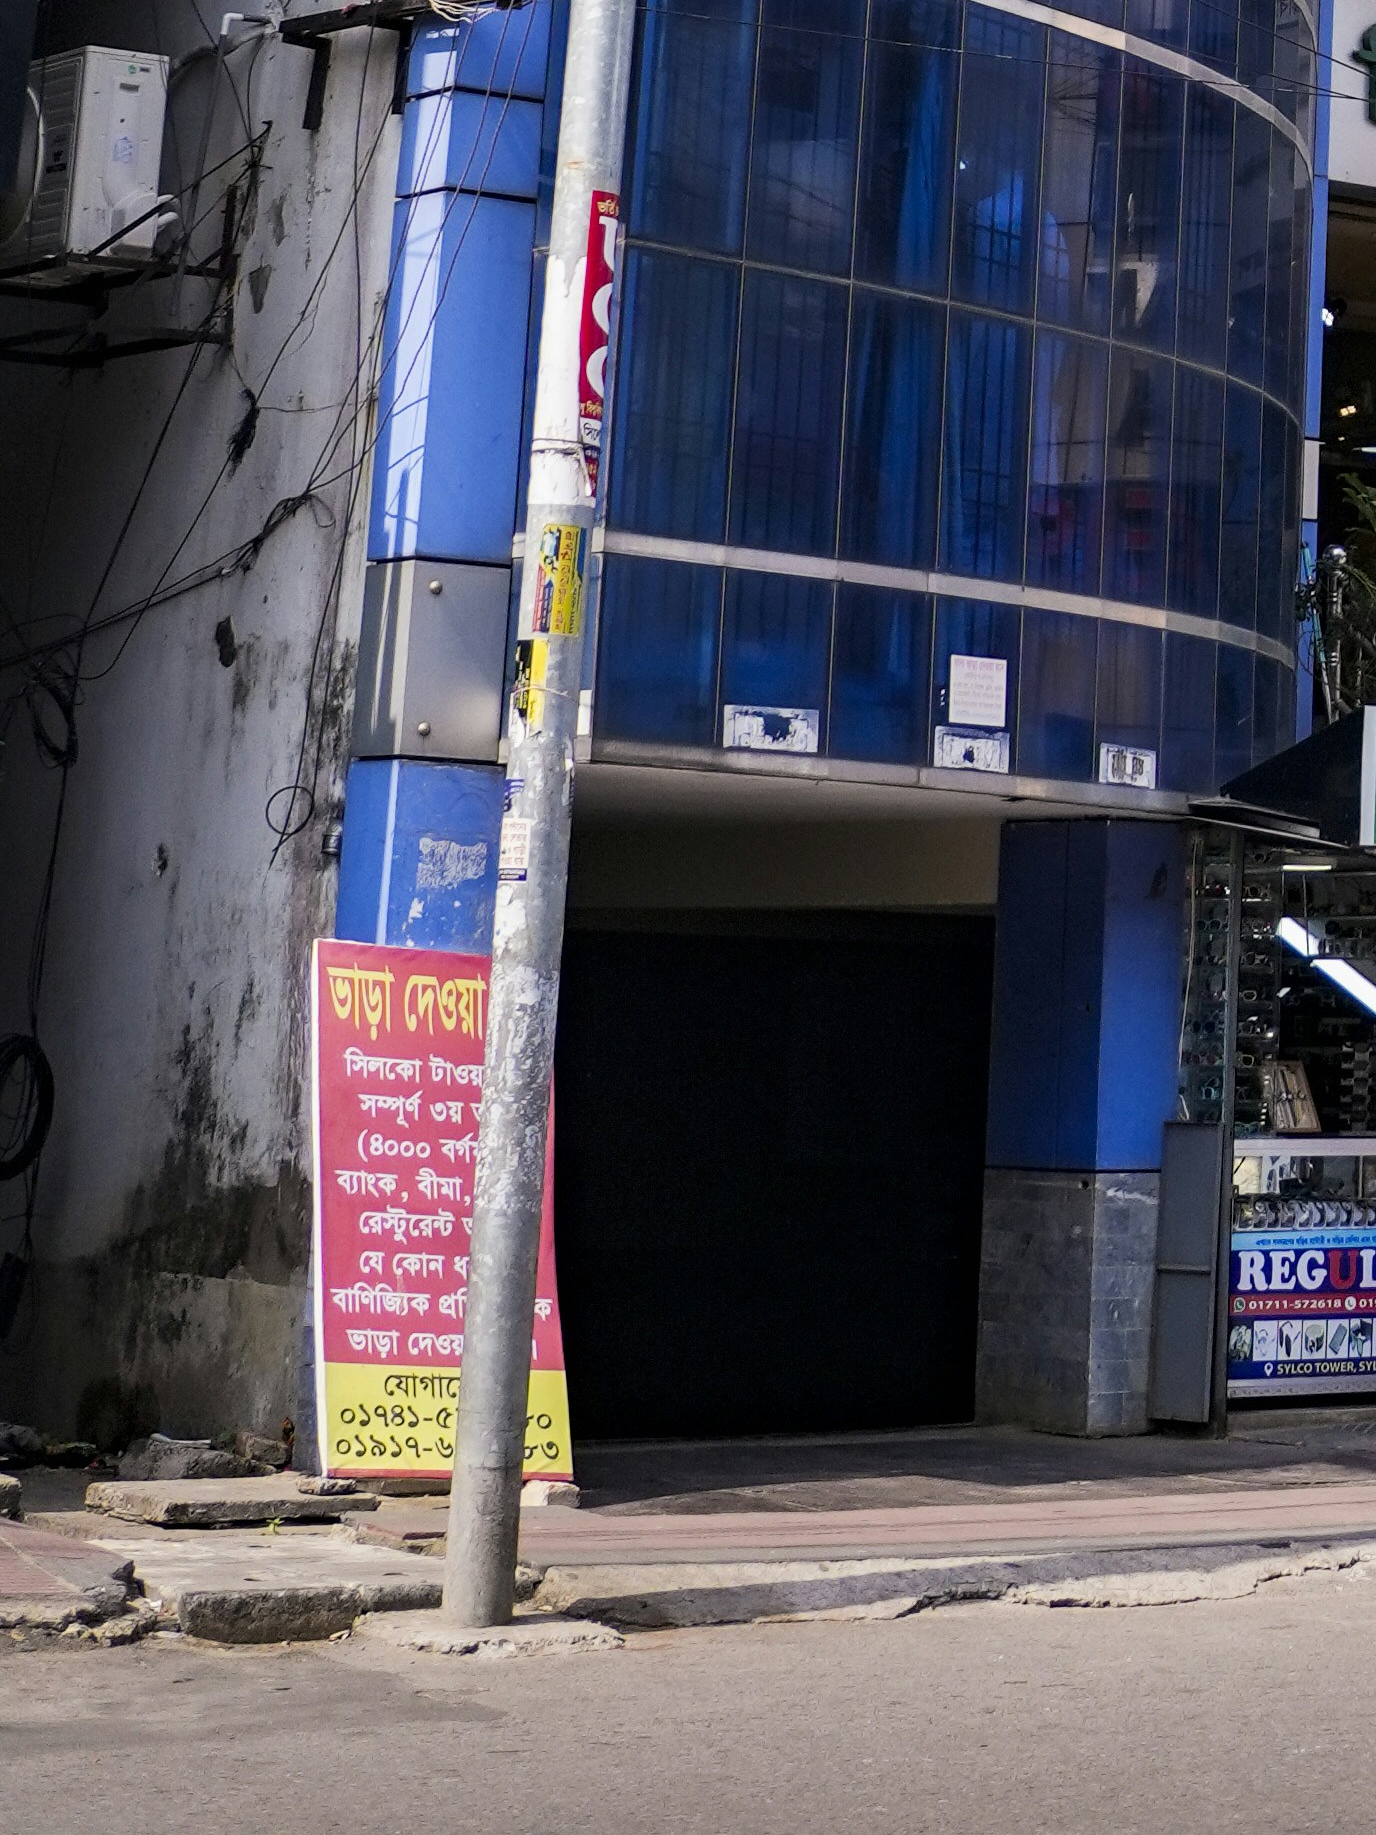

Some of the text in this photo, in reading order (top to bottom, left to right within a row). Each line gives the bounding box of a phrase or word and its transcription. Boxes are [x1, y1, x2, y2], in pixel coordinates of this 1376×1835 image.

[326, 961, 394, 1042] ভাড়া
[345, 1047, 421, 1084] সিলকো
[358, 1093, 421, 1128] সম্পূর্ণ
[357, 1134, 431, 1161] (৪০০০
[335, 1170, 472, 1207] ব্যাংক, বীমা,
[358, 1207, 456, 1245] রেস্টুরেন্ট
[359, 1252, 447, 1280] যে কোন
[330, 1286, 431, 1319] বাণিজ্যিক
[346, 1329, 400, 1359] ভাড়া
[1276, 1363, 1311, 1375] SYLCO
[1314, 1361, 1357, 1374] TOWER,
